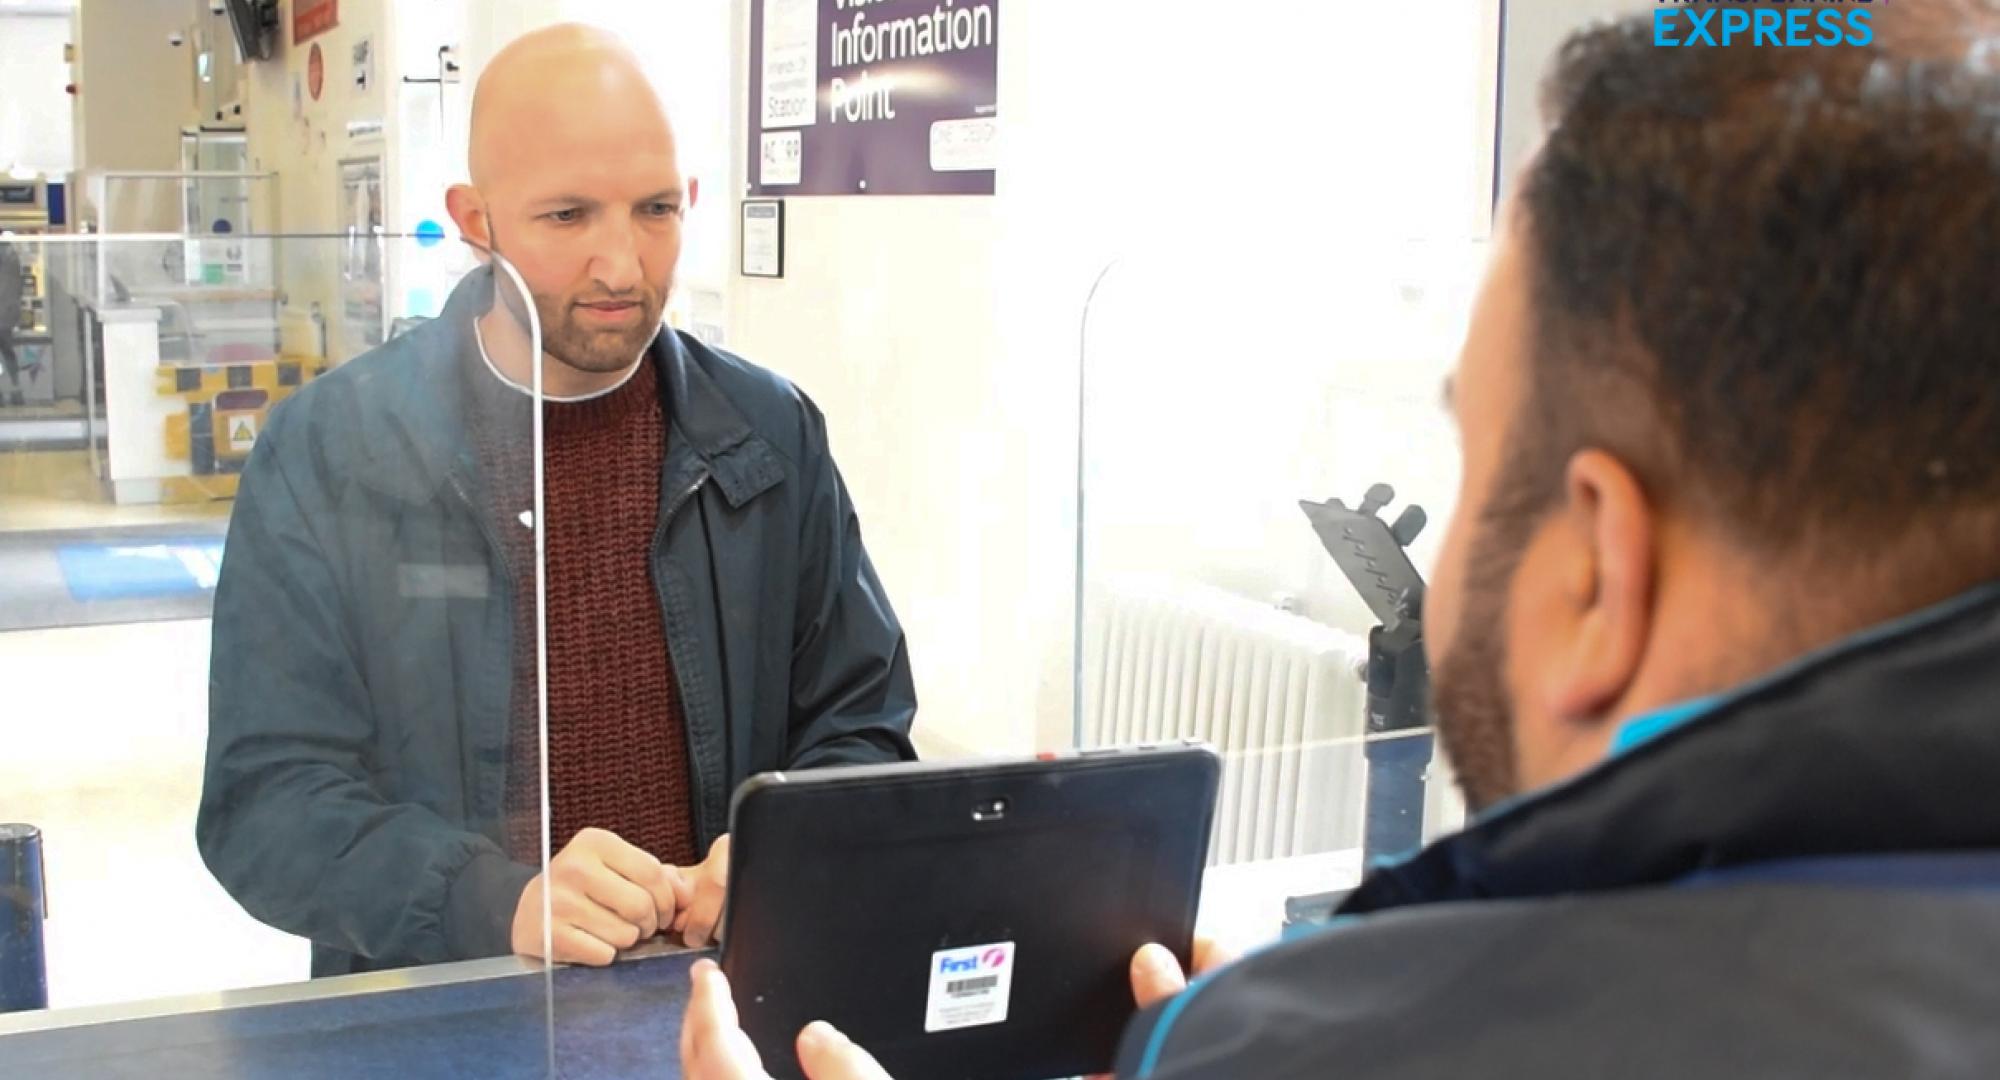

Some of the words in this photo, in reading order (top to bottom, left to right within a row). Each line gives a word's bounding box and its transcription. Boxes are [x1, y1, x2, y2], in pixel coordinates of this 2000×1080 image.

[831, 0, 992, 67] Information
[830, 71, 896, 124] Point
[940, 955, 978, 974] First
